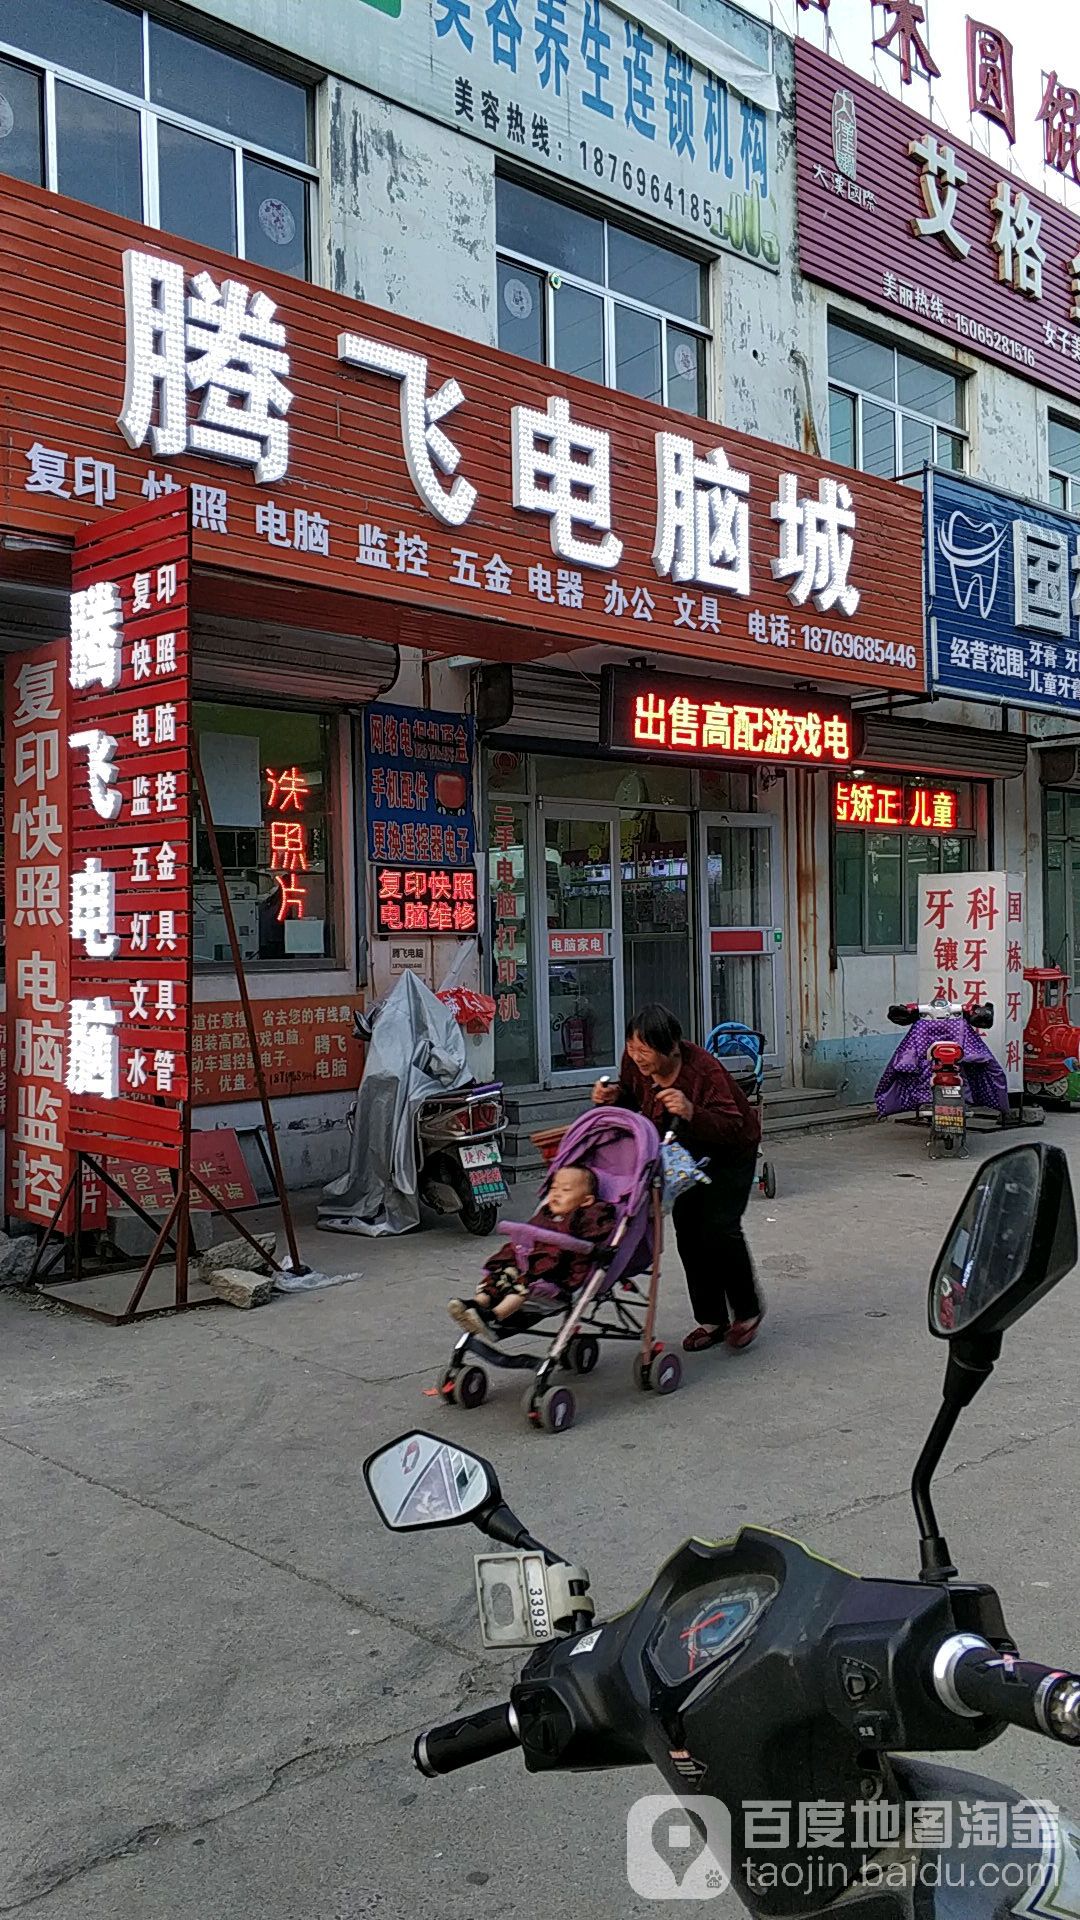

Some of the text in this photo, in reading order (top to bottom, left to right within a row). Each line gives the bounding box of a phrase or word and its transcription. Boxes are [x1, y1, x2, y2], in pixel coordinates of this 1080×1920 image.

[907, 133, 1080, 323] 艾格
[116, 248, 861, 617] 腾飞电脑城
[24, 442, 116, 507] 复印
[255, 500, 329, 557] 电脑
[355, 522, 430, 578] 监控
[450, 546, 512, 597] 五金
[527, 562, 584, 610] 电器
[604, 579, 656, 623] 办公
[673, 592, 721, 634] 文具
[747, 608, 917, 670] 电话:18769685446
[1012, 519, 1080, 637] 国
[131, 563, 177, 614] 复印
[131, 632, 178, 681] 快照
[1029, 640, 1058, 669] 牙膏
[1065, 648, 1080, 672] 牙
[131, 702, 177, 748] 电脑
[634, 693, 850, 760] 出售高配游戏电
[131, 771, 177, 816] 监控
[371, 767, 429, 812] 手机配件
[909, 790, 954, 828] 儿童
[130, 840, 177, 882] 五金
[265, 766, 309, 921] 洗照片
[372, 820, 470, 864] 更换遥控器电子
[379, 868, 476, 901] 复印快照
[129, 910, 177, 951] 灯具
[380, 901, 477, 931] 电脑维修
[494, 805, 521, 1023] 二手电脑打印机
[923, 886, 1000, 931] 牙科
[12, 659, 64, 1223] 复印快照 电脑监控
[551, 937, 602, 953] 电脑家电
[933, 937, 988, 973] 镶牙
[128, 979, 177, 1022] 文具
[262, 1006, 355, 1026] 省去您的有线费
[126, 1048, 175, 1092] 水管
[315, 1058, 348, 1080] 电脑
[528, 1587, 549, 1638] 33938
